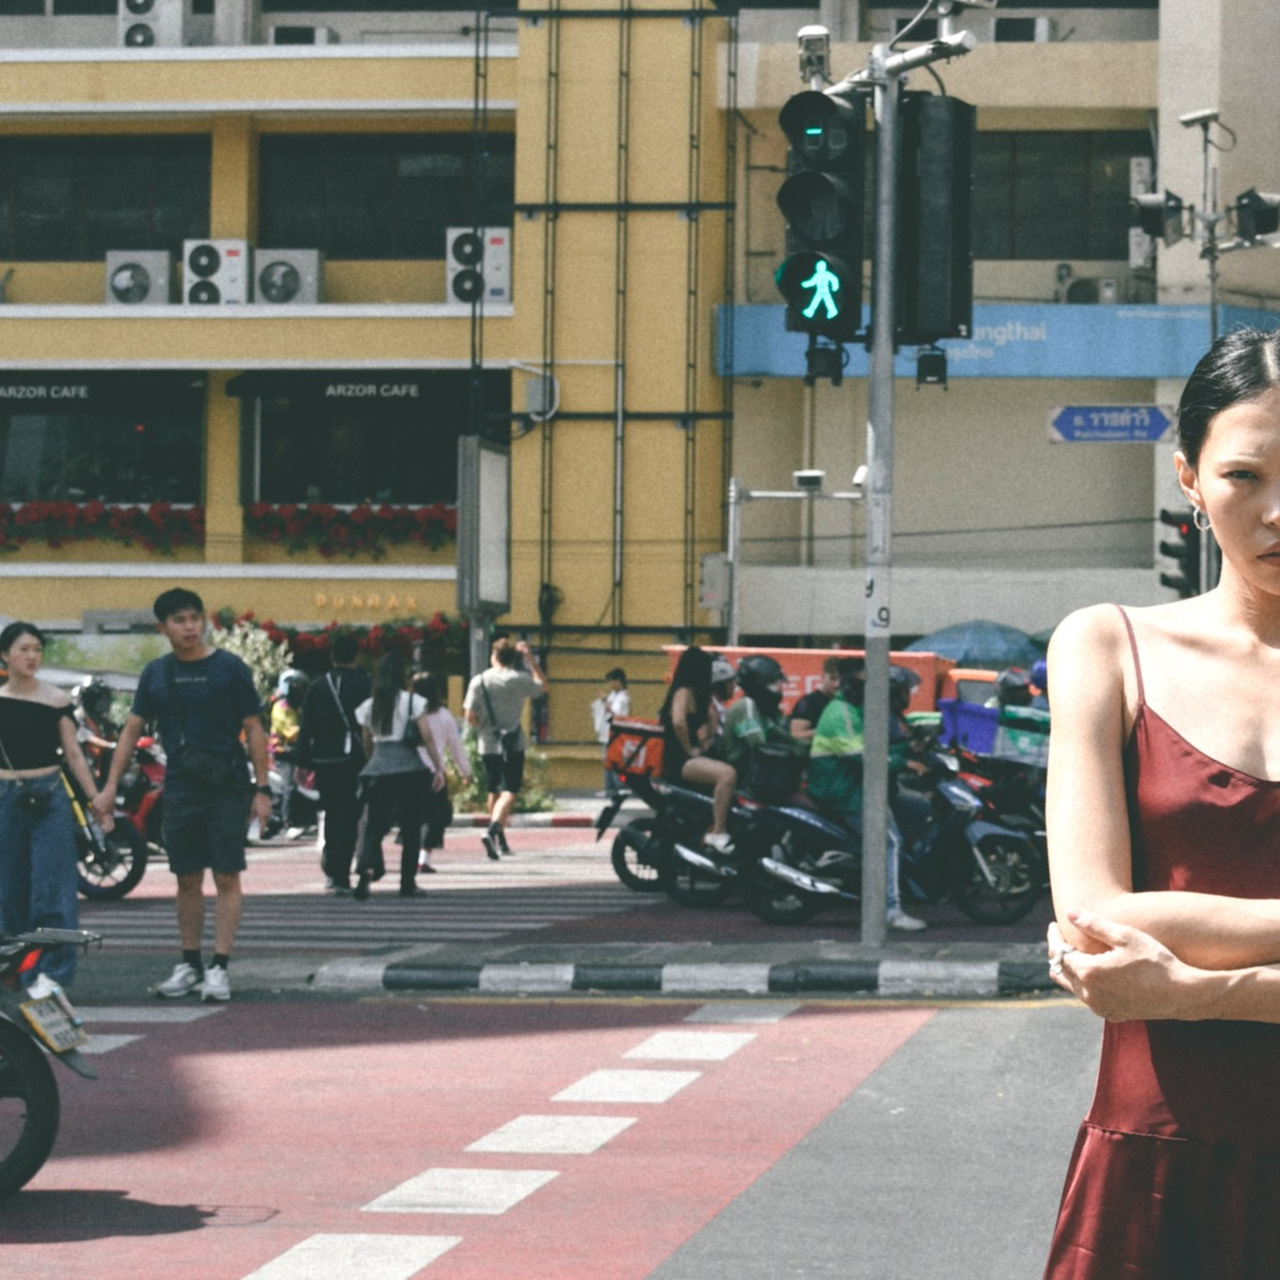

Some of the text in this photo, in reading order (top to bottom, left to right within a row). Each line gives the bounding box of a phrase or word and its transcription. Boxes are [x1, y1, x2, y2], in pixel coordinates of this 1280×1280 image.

[0, 385, 89, 398] ARZOR CAFE
[326, 384, 419, 397] ARZOR CAFE
